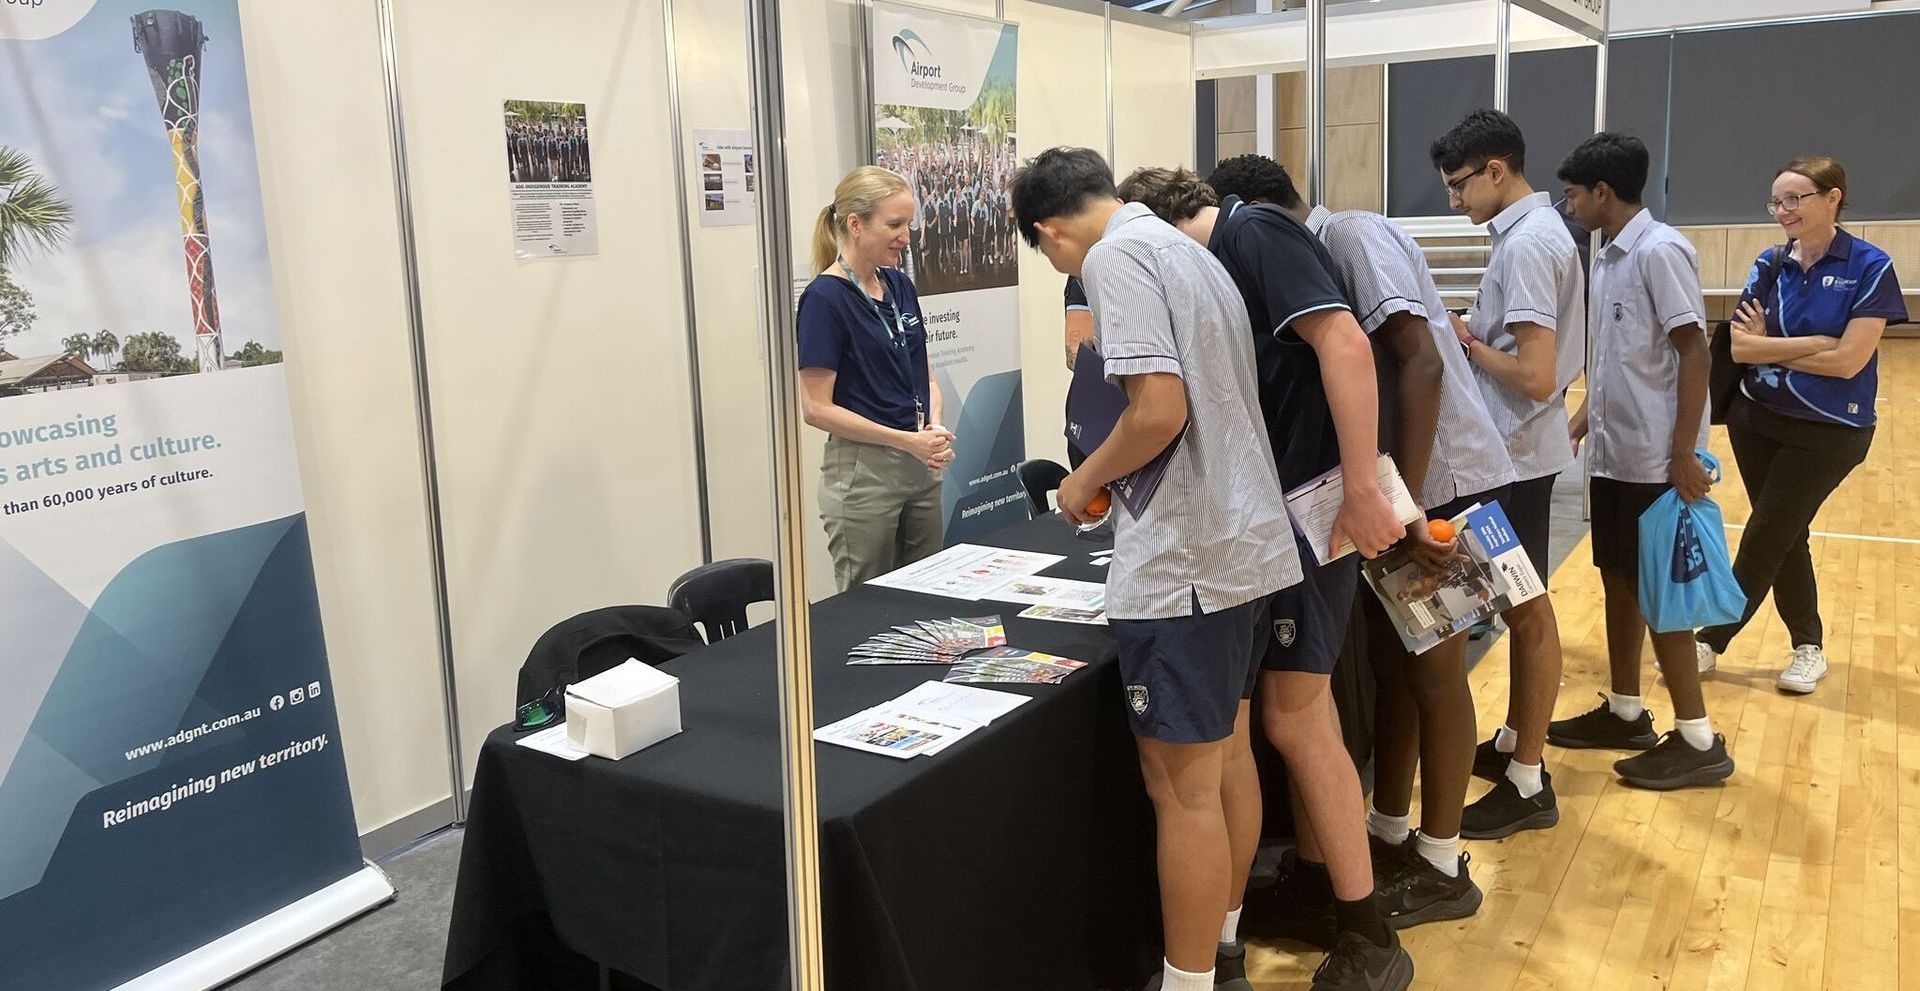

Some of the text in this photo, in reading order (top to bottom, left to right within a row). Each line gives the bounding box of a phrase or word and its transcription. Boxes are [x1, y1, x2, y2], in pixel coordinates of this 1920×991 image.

[911, 61, 941, 78] Airport
[911, 78, 966, 94] Development Group
[929, 309, 960, 323] investing
[936, 330, 958, 341] future.
[16, 457, 68, 482] arts
[76, 444, 122, 471] and
[130, 434, 222, 462] culture.
[4, 467, 213, 515] than 60,000 years of culture.
[962, 500, 994, 519] Reimagining
[995, 497, 1005, 507] new
[1508, 567, 1528, 596] DARWIN
[125, 706, 261, 760] www.adgnt.com.au
[103, 732, 328, 828] Reimagining new territory.
